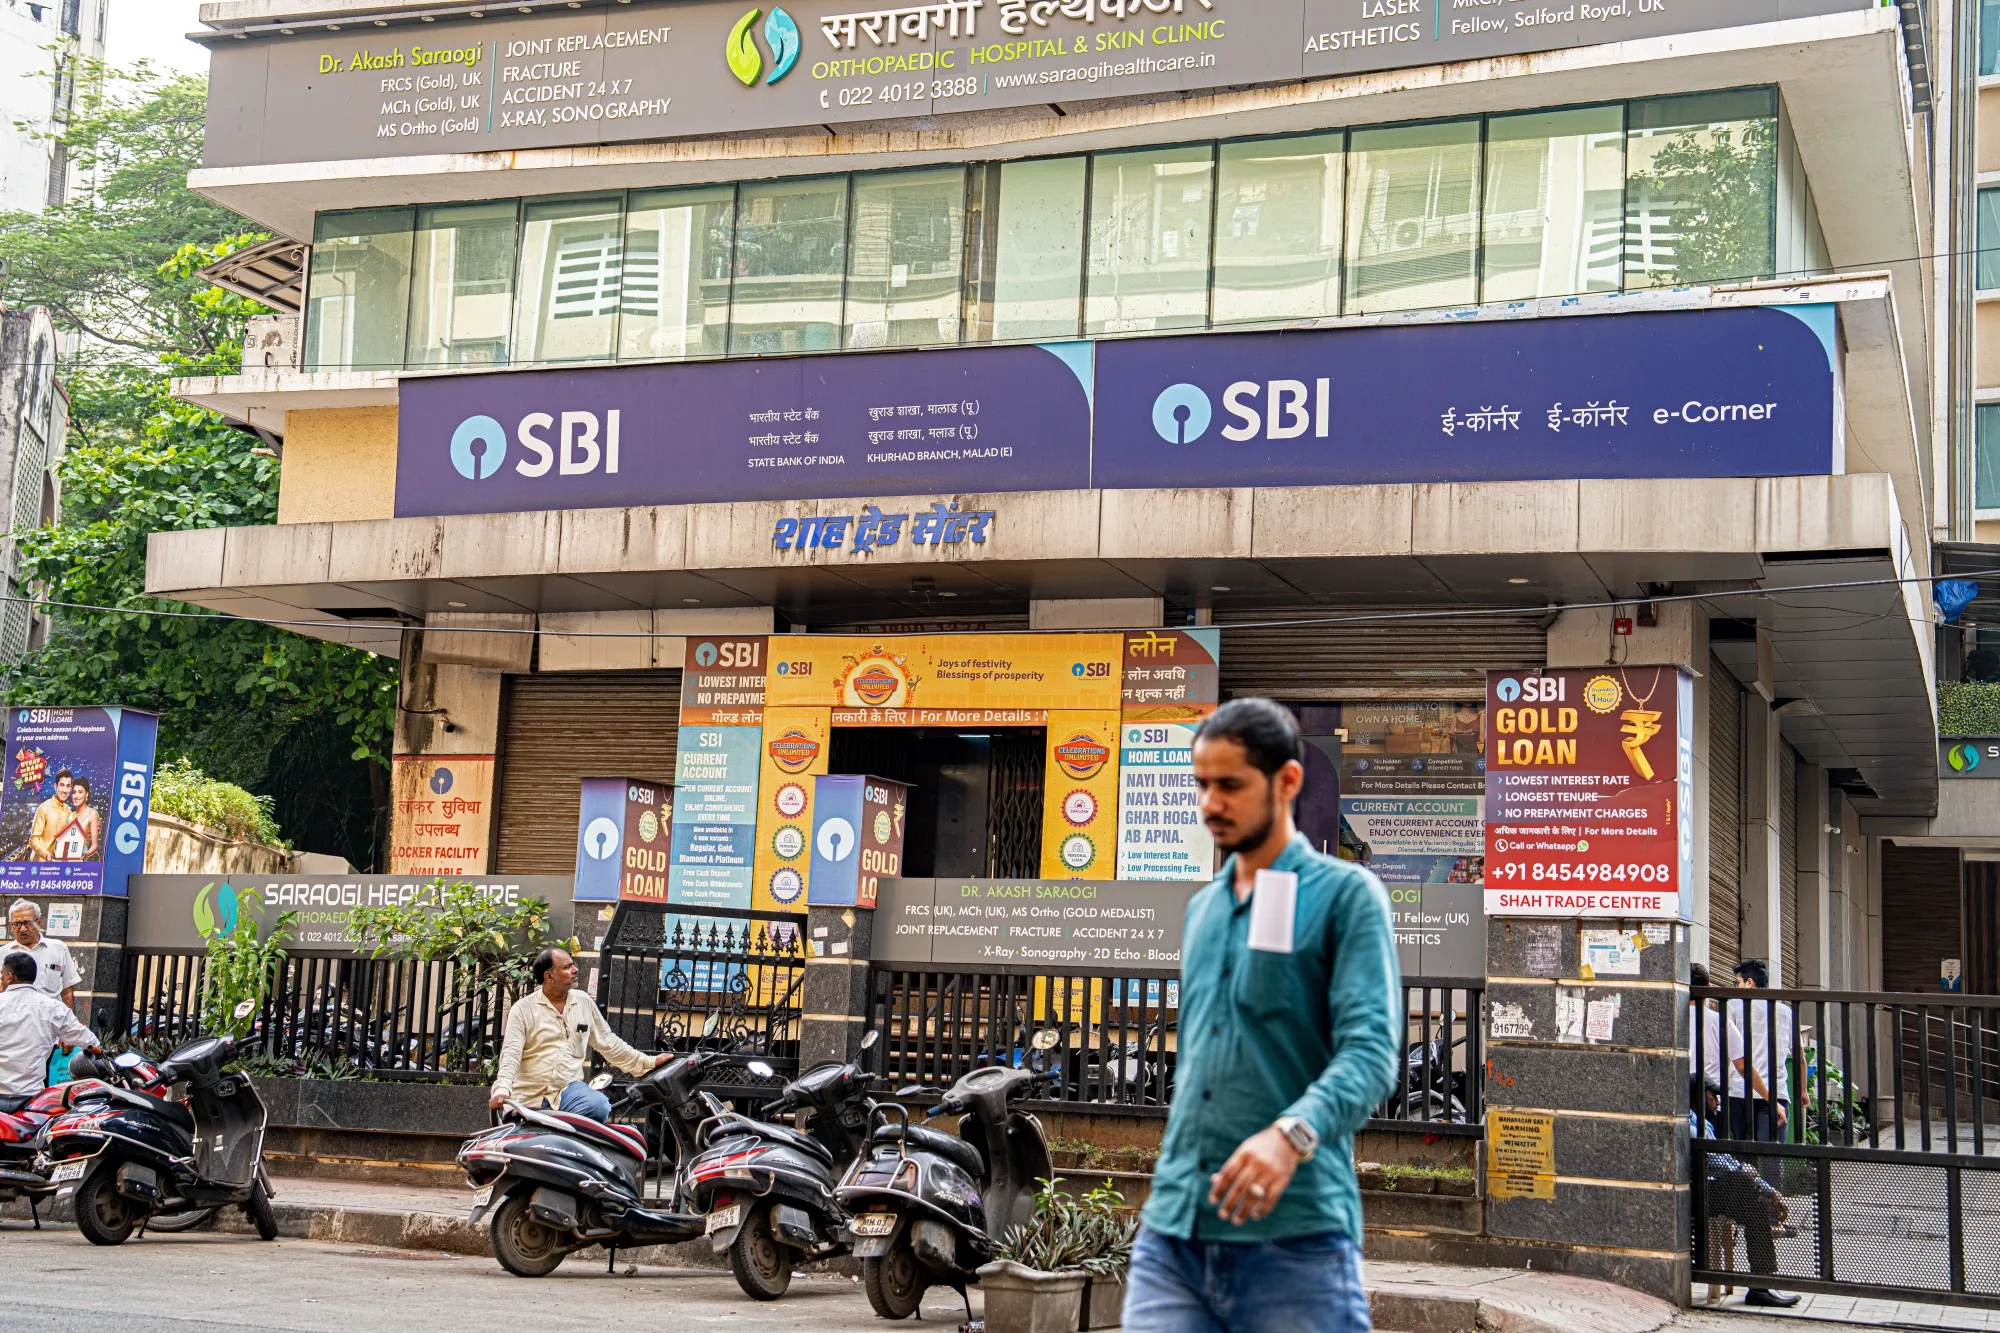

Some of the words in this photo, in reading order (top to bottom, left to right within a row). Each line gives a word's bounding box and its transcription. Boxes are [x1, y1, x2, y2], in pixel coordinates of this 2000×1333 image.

[1362, 0, 1420, 19] LASER
[1451, 15, 1510, 37] Fellow,
[1514, 8, 1575, 29] Salford
[1580, 0, 1632, 24] Royal,
[1639, 0, 1665, 14] UK
[505, 38, 551, 58] JOINT
[557, 27, 671, 52] REPLACEMENT
[1304, 22, 1420, 54] AESTHETICS
[319, 54, 343, 74] Dr.
[349, 49, 405, 71] Akash
[410, 41, 483, 67] Saraogi
[812, 50, 955, 81] ORTHOPAEDIC
[970, 39, 1068, 66] HOSPITAL
[1074, 35, 1089, 54] &
[1095, 28, 1146, 54] SKIN
[1151, 19, 1226, 46] CLINIC
[503, 61, 581, 83] FRACTURE
[995, 51, 1216, 90] www.saraogihealthcare.in
[381, 79, 412, 93] FRCS
[415, 74, 456, 93] (Gold),
[463, 71, 482, 86] UK
[501, 83, 583, 105] ACCIDENT
[587, 81, 605, 97] 24
[609, 80, 622, 95] X
[624, 79, 633, 94] 7
[839, 87, 874, 107] 022
[879, 82, 924, 103] 4012
[931, 77, 978, 100] 3388
[380, 100, 411, 115] MCh
[414, 97, 456, 115] (Gold),
[461, 96, 480, 110] UK
[501, 108, 547, 129] X-RAY,
[551, 97, 671, 123] SONOGRAPHY
[377, 123, 397, 138] MS
[401, 121, 437, 137] Ortho
[441, 117, 479, 136] (Gold)
[749, 410, 781, 424] भारतीय
[783, 408, 803, 422] स्टेट
[1221, 377, 1330, 442] SBI
[1653, 400, 1777, 425] e-Corner
[1440, 405, 1522, 437] ई-कॉर्नर
[1547, 400, 1629, 432] ई-कॉर्नर
[515, 409, 620, 478] SBI
[748, 434, 780, 447] भारतीय
[782, 432, 802, 445] स्टेट
[748, 458, 777, 468] STATE
[777, 457, 803, 467] BANK
[804, 456, 817, 466] OF
[818, 455, 845, 466] INDIA
[867, 451, 916, 464] KHURHAD
[917, 449, 961, 462] BRANCH,
[962, 447, 998, 459] MALAD
[999, 446, 1013, 458] (E)
[772, 515, 854, 550] शाह
[850, 504, 909, 553] ट्रेड
[912, 501, 996, 545] सेंटर
[1129, 631, 1177, 658] लोन
[718, 642, 760, 668] SBI
[790, 661, 813, 676] SBI
[937, 659, 958, 670] Joys
[961, 659, 971, 668] of
[972, 659, 1012, 671] festivity
[1086, 662, 1111, 677] SBI
[937, 670, 980, 681] Blessings
[982, 670, 993, 680] of
[994, 671, 1044, 682] prosperity
[1522, 677, 1565, 702] SBI
[30, 709, 51, 724] SBI
[920, 710, 943, 722] For
[946, 710, 981, 722] More
[984, 709, 1031, 722] Details
[1496, 707, 1578, 734] GOLD
[699, 733, 722, 747] SBI
[1144, 729, 1168, 743] SBI
[683, 753, 728, 765] CURRENT
[1128, 751, 1160, 763] HOME
[1163, 752, 1192, 764] LOAN
[1497, 739, 1577, 765] LOAN
[683, 767, 727, 779] ACCOUNT
[1505, 776, 1549, 786] LOWEST
[1551, 776, 1600, 785] INTEREST
[1603, 776, 1630, 785] RATE
[118, 761, 148, 821] SBI
[1361, 781, 1374, 789] For
[1375, 781, 1393, 789] More
[1395, 781, 1420, 789] Details
[638, 788, 654, 805] SBI
[1505, 792, 1555, 802] LONGEST
[1557, 792, 1598, 802] TENURE
[1351, 802, 1404, 812] CURRENT
[1406, 802, 1465, 813] ACCOUNT
[1505, 809, 1522, 818] NO
[1524, 808, 1593, 818] PREPAYMENT
[1595, 808, 1648, 819] CHARGES
[1125, 810, 1159, 825] GHAR
[1164, 811, 1198, 825] HOGA
[415, 823, 461, 837] उपलब्ध
[1125, 829, 1141, 843] AB
[1145, 830, 1184, 844] APNA.
[1584, 827, 1599, 836] For
[1601, 827, 1624, 836] More
[1626, 827, 1658, 836] Details
[392, 847, 431, 858] LOCKER
[435, 847, 479, 859] FACILITY
[1509, 842, 1525, 850] Call
[1536, 842, 1576, 852] Whatsapp
[626, 847, 666, 873] GOLD
[1128, 851, 1142, 859] Low
[1144, 851, 1171, 859] Interest
[1173, 852, 1189, 860] Rate
[1144, 865, 1182, 874] Processing
[1184, 865, 1201, 873] Fees
[1492, 863, 1527, 880] +91
[1532, 863, 1669, 882] 8454984908
[0, 880, 24, 890] Mob.:
[25, 880, 39, 890] +91
[41, 880, 93, 890] 8454984908
[626, 873, 665, 899] LOAN
[961, 886, 982, 898] DR.
[986, 886, 1031, 898] AKASH
[1035, 886, 1096, 899] SARAOGI
[264, 884, 362, 906] SARAOGI
[1500, 894, 1542, 907] SHAH
[1545, 895, 1596, 908] TRADE
[1599, 896, 1661, 909] CENTRE
[905, 905, 930, 915] FRCS
[933, 905, 955, 918] (UK),
[959, 906, 982, 916] MCh
[985, 906, 1008, 919] (UK),
[1012, 907, 1028, 917] MS
[1030, 906, 1059, 918] Ortho
[1063, 907, 1097, 920] (GOLD
[1100, 907, 1155, 921] MEDALIST)
[1405, 911, 1441, 923] Fellow
[1445, 912, 1469, 926] (UK)
[984, 946, 1015, 959] X-Ray
[1021, 947, 1087, 961] Sonography
[1093, 948, 1110, 960] 2D
[1114, 948, 1140, 960] Echo
[1148, 949, 1180, 961] Blood
[1502, 1125, 1540, 1133] WARNING
